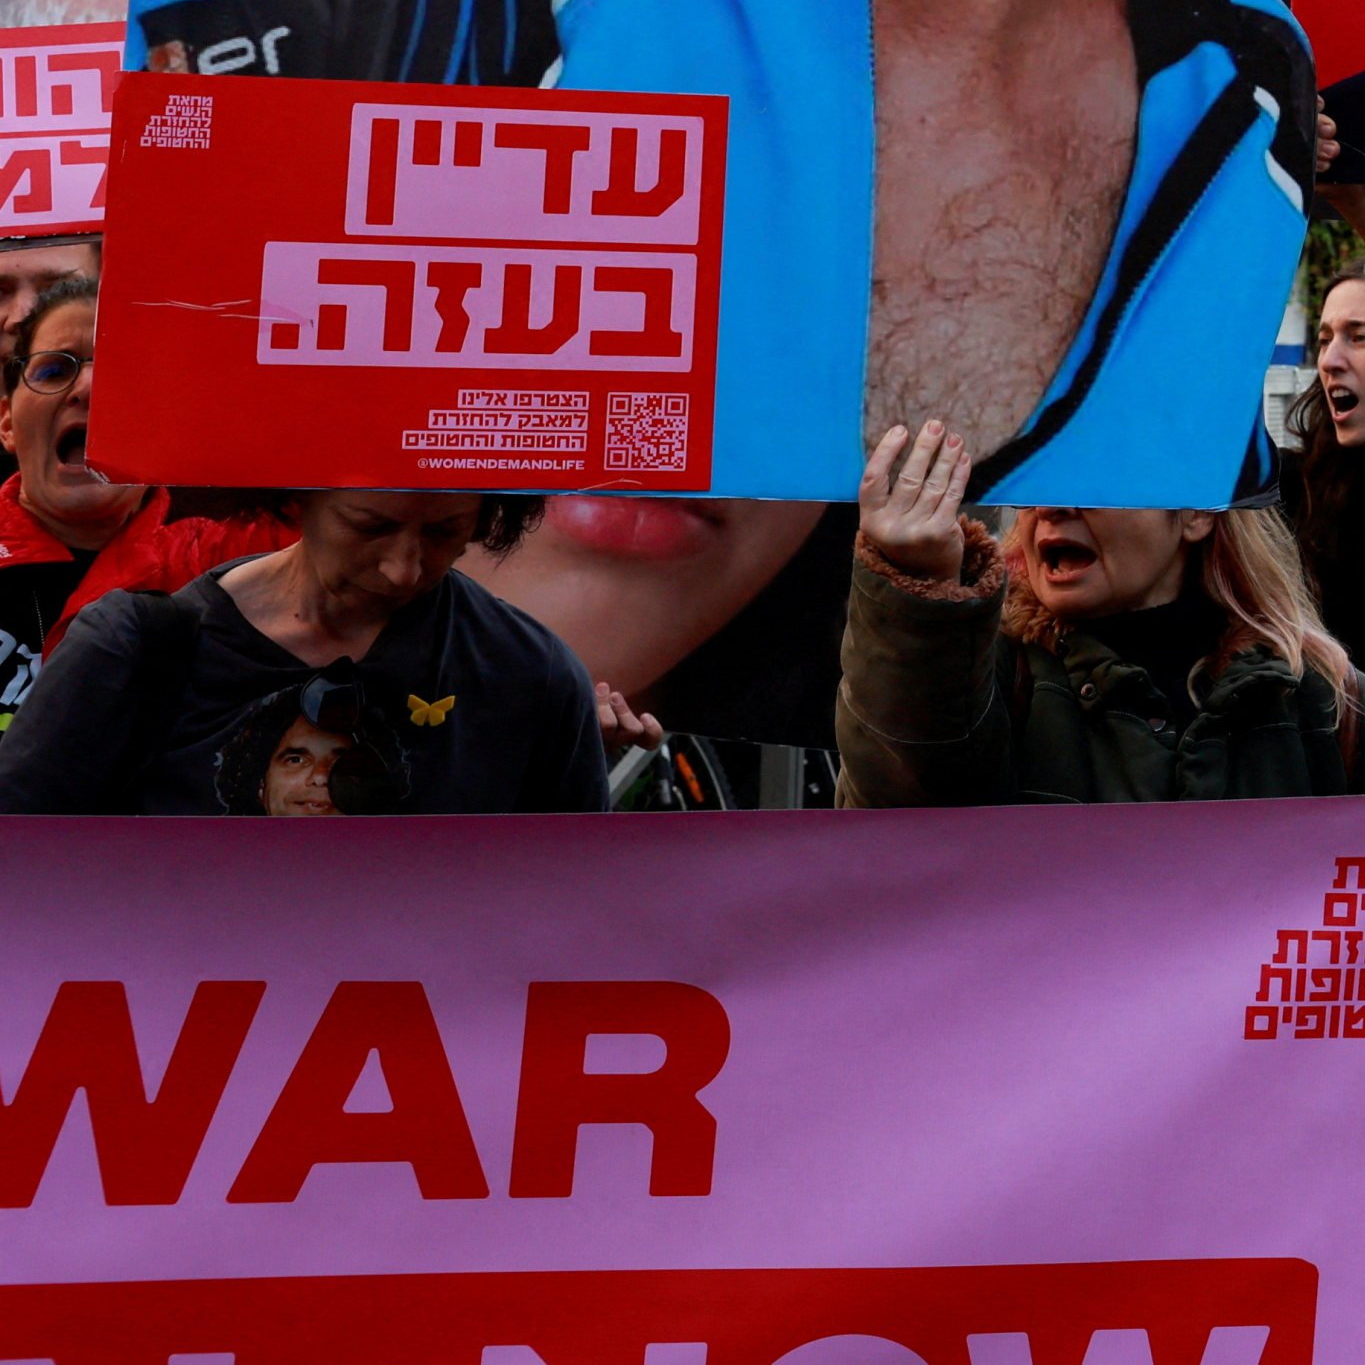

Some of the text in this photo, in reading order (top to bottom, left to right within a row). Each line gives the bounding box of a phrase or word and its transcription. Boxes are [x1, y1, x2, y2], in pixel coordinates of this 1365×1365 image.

[168, 95, 213, 106] מחאת
[165, 105, 212, 117] הנשים
[149, 115, 212, 127] להחזרת
[144, 125, 211, 138] החטופות
[140, 136, 210, 149] והחטופים
[366, 118, 686, 225] עדיין
[271, 259, 682, 357] בעזה.
[461, 391, 588, 408] הצטרפו אלינו
[432, 411, 587, 429] למאבק להחזרת
[405, 432, 585, 448] החטופות והחטופים
[417, 457, 585, 471] @WOMENDEMANDLIFE
[0, 981, 730, 1208] WAR
